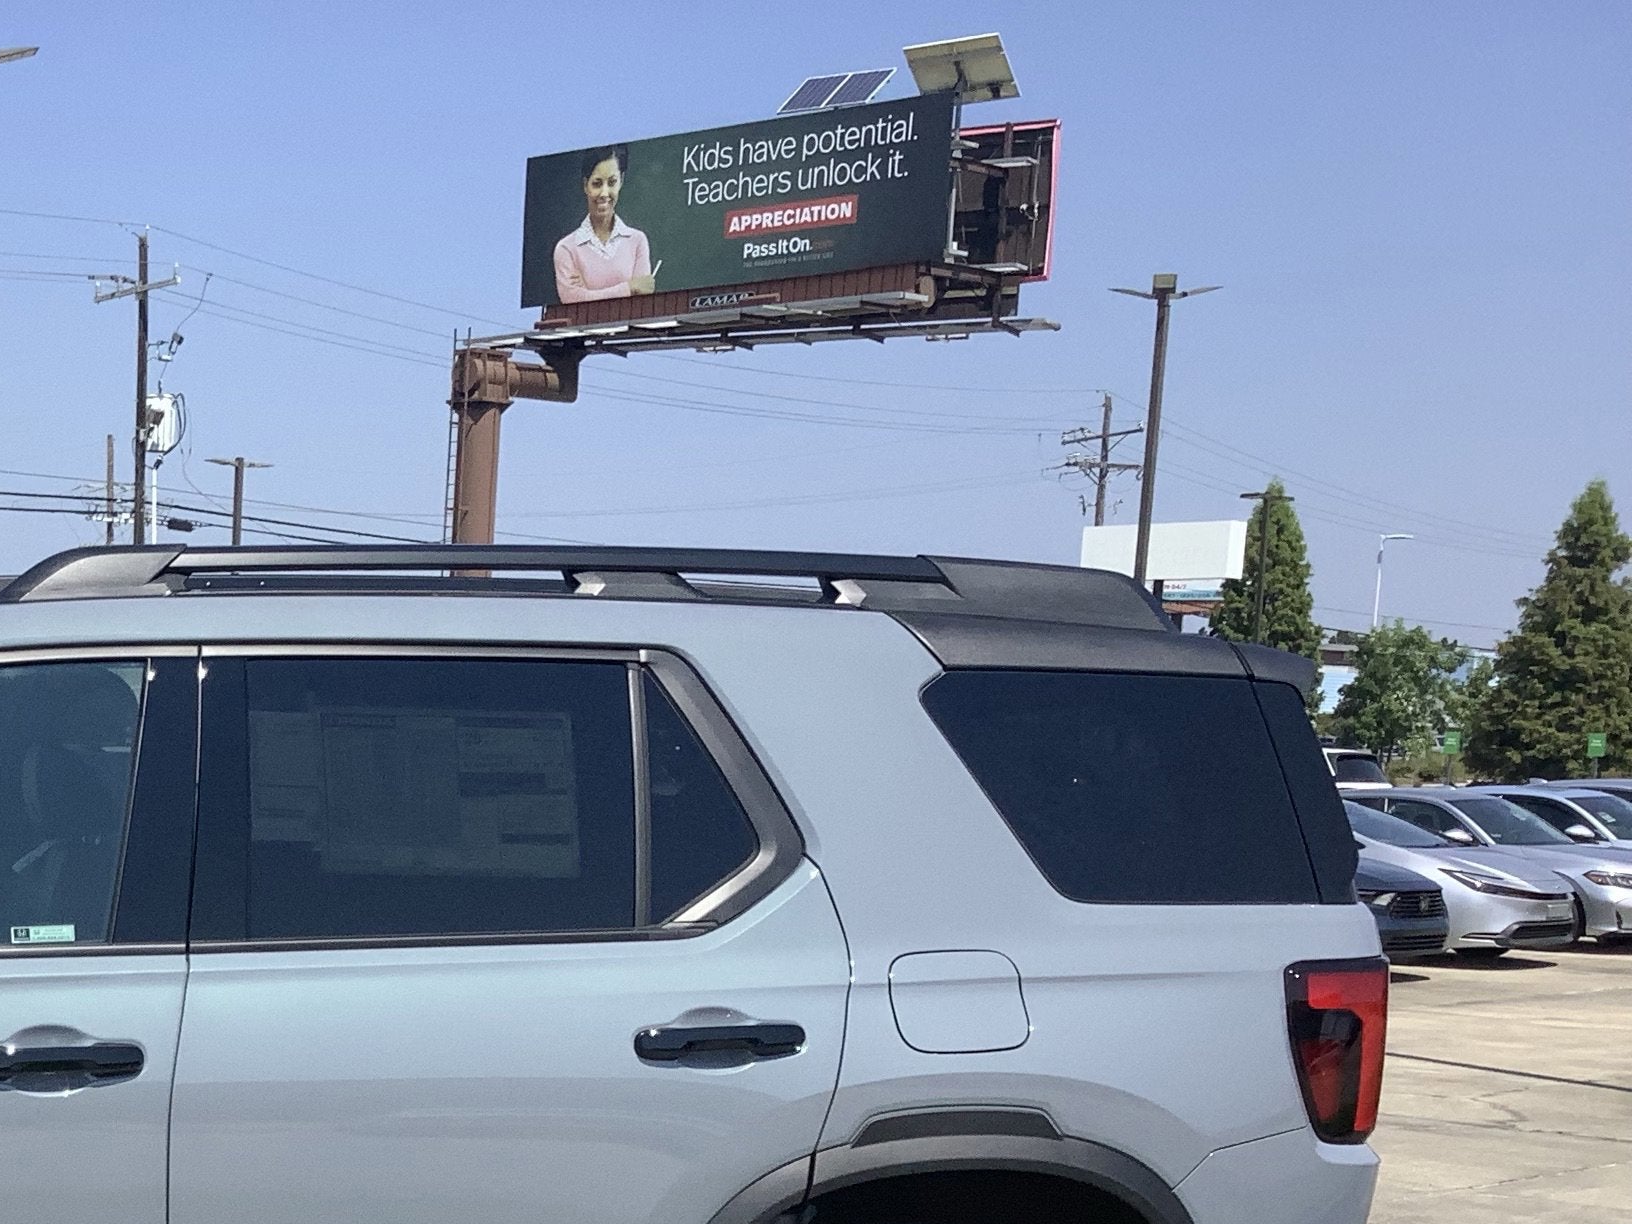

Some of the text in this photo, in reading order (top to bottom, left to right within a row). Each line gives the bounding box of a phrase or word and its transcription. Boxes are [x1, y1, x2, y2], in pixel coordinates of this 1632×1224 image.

[682, 112, 918, 173] Kids have potential.
[683, 150, 909, 206] Teachers unlock it.
[729, 201, 853, 233] APPRECIATION
